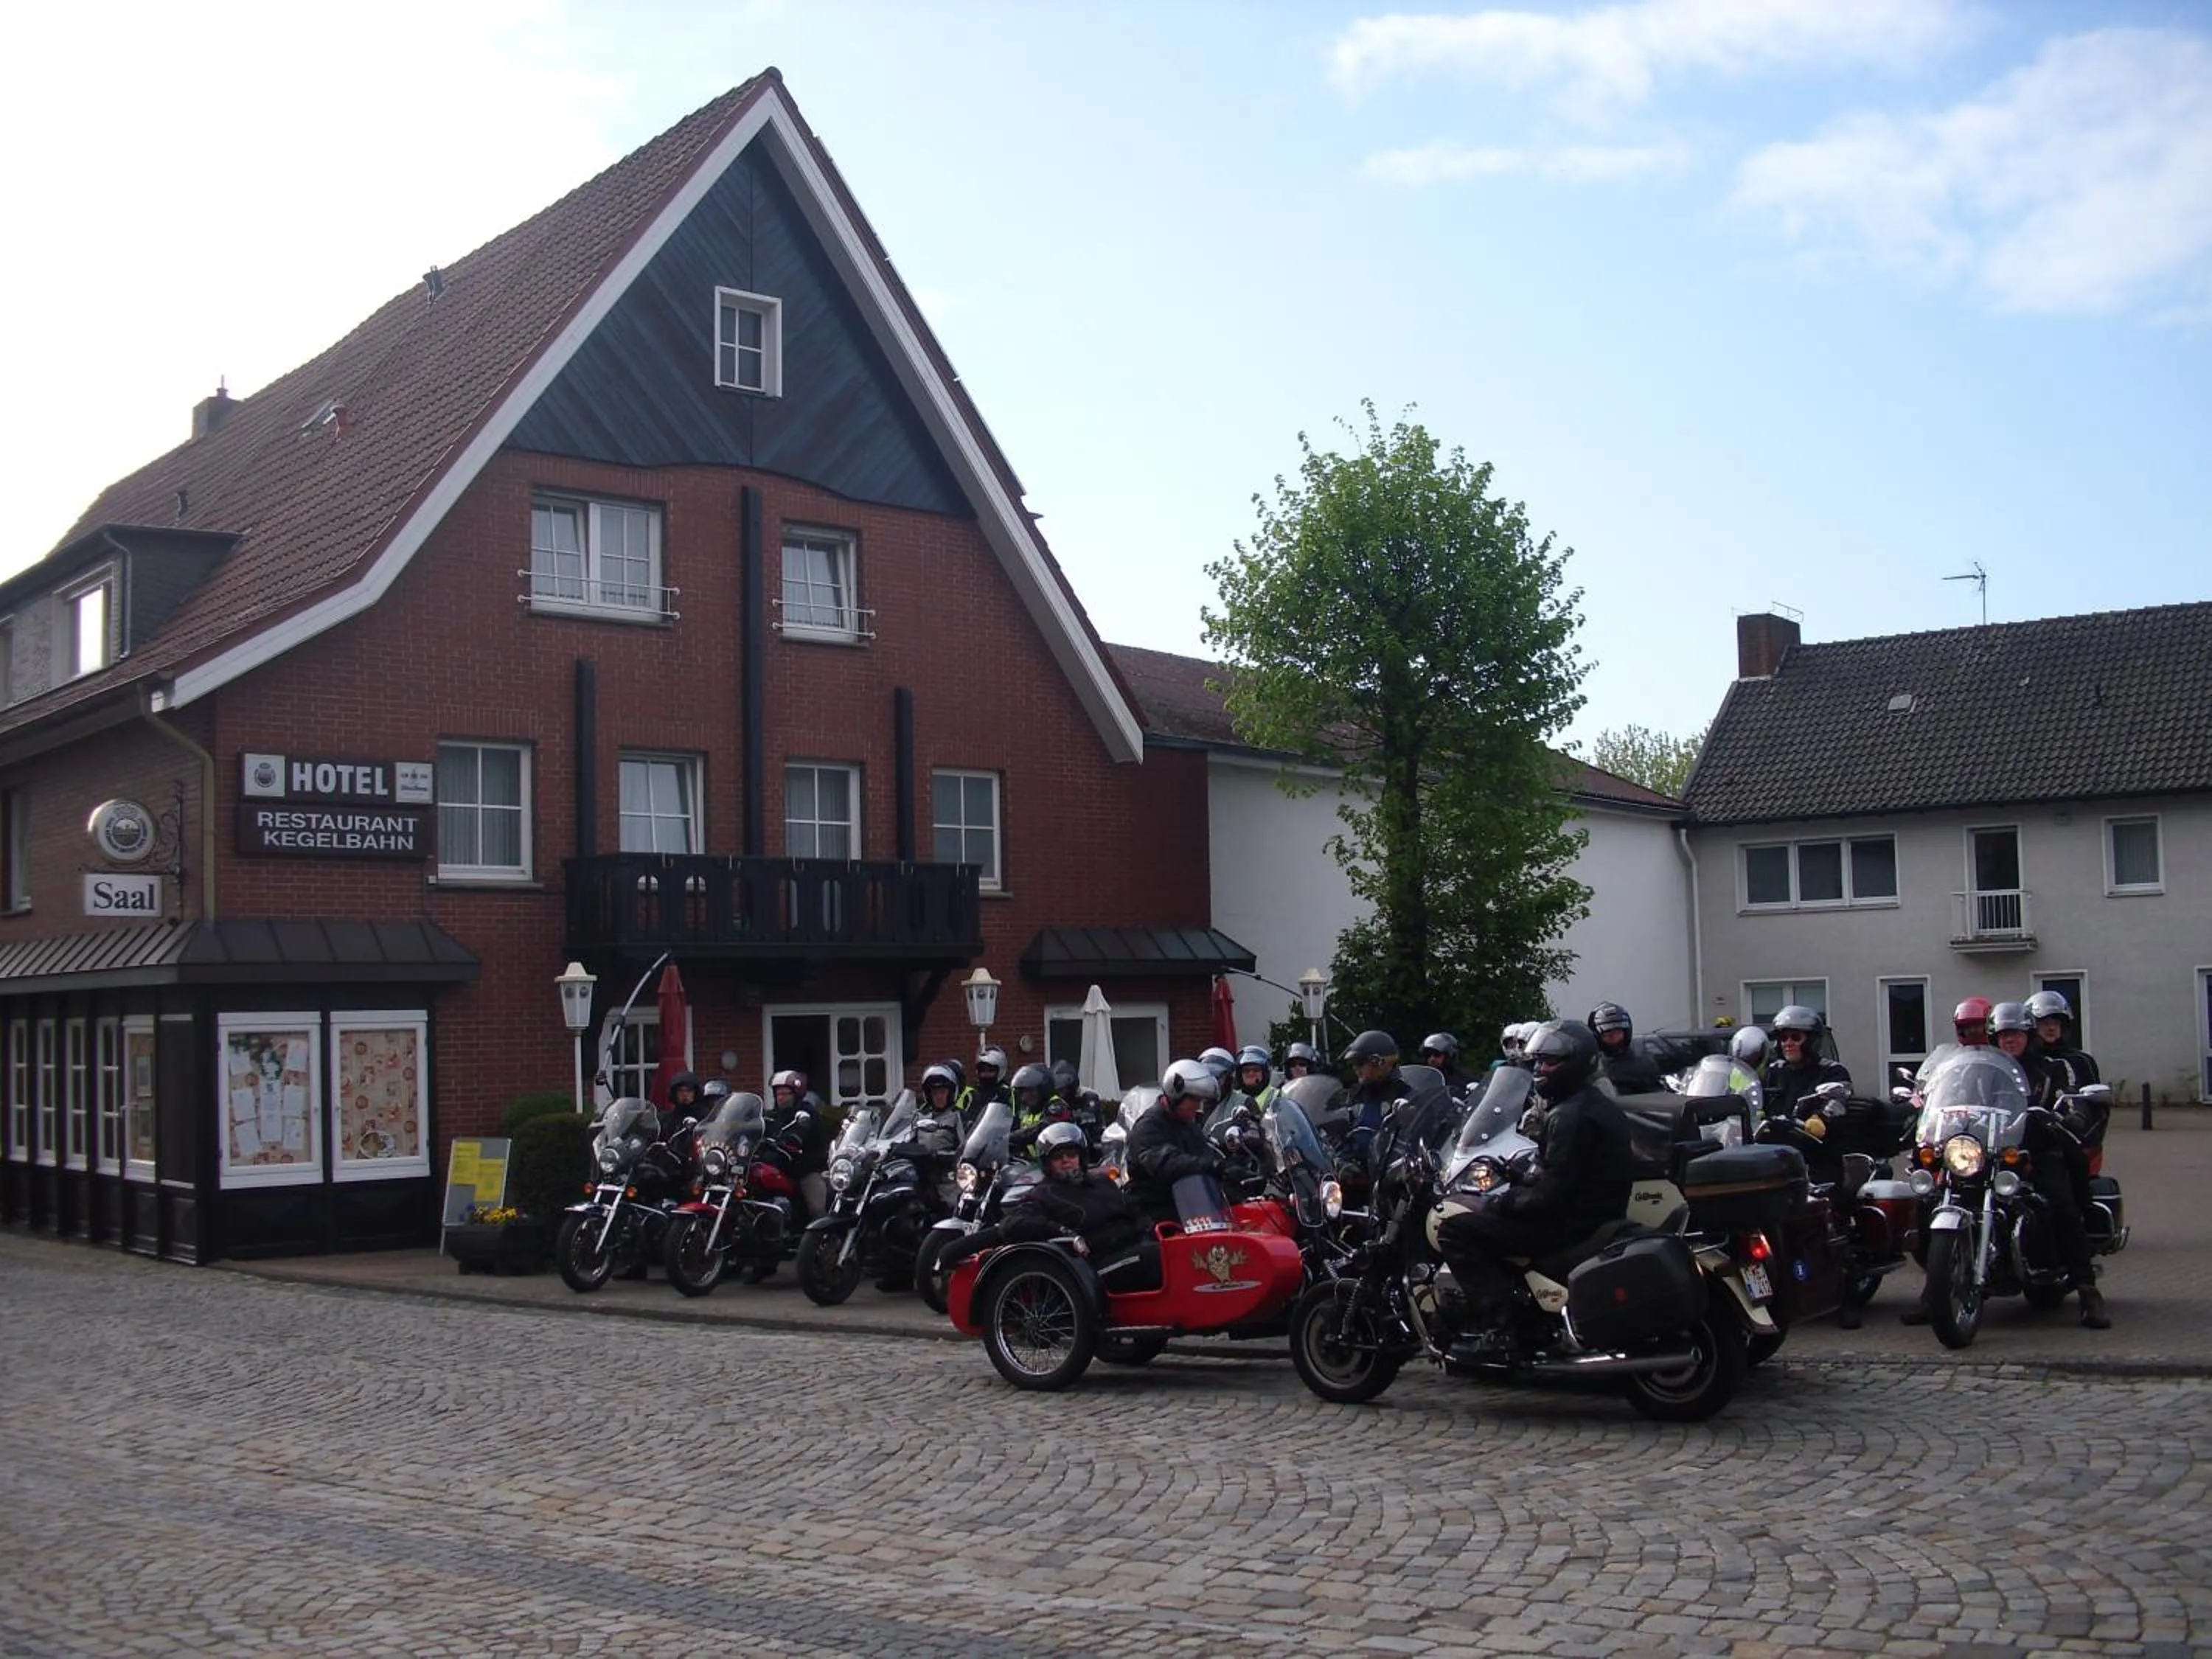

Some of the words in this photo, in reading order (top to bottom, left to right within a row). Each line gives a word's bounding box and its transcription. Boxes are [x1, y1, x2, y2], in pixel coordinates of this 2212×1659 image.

[292, 762, 389, 796] HOTEL
[257, 811, 418, 832] RESTAURANT
[264, 830, 414, 850] KEGELBAHN
[94, 881, 156, 911] Saal
